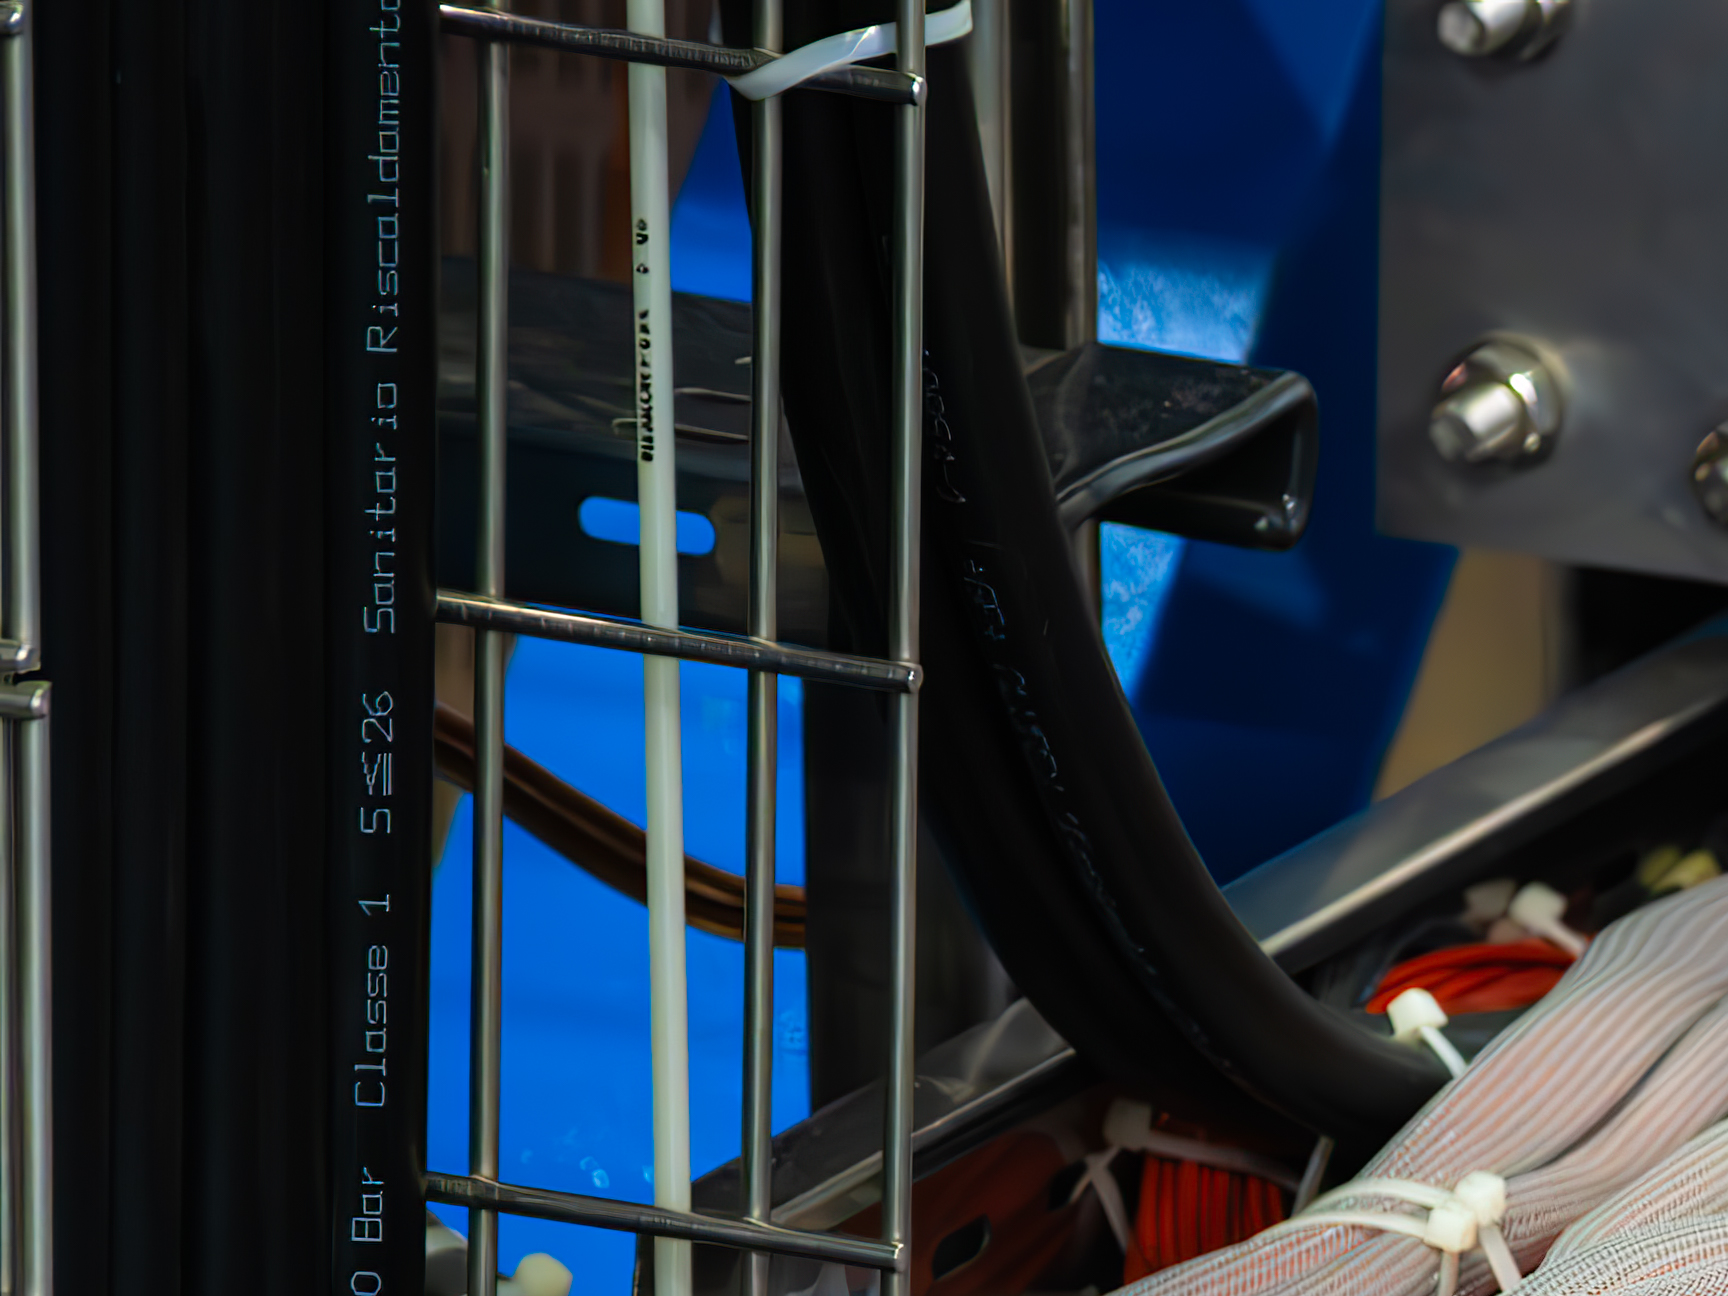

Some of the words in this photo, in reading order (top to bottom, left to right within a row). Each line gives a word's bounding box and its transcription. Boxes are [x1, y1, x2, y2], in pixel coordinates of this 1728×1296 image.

[364, 383, 397, 633] Sanitario
[358, 894, 389, 915] 1
[354, 945, 388, 1107] Classe
[351, 1167, 384, 1242] Bar
